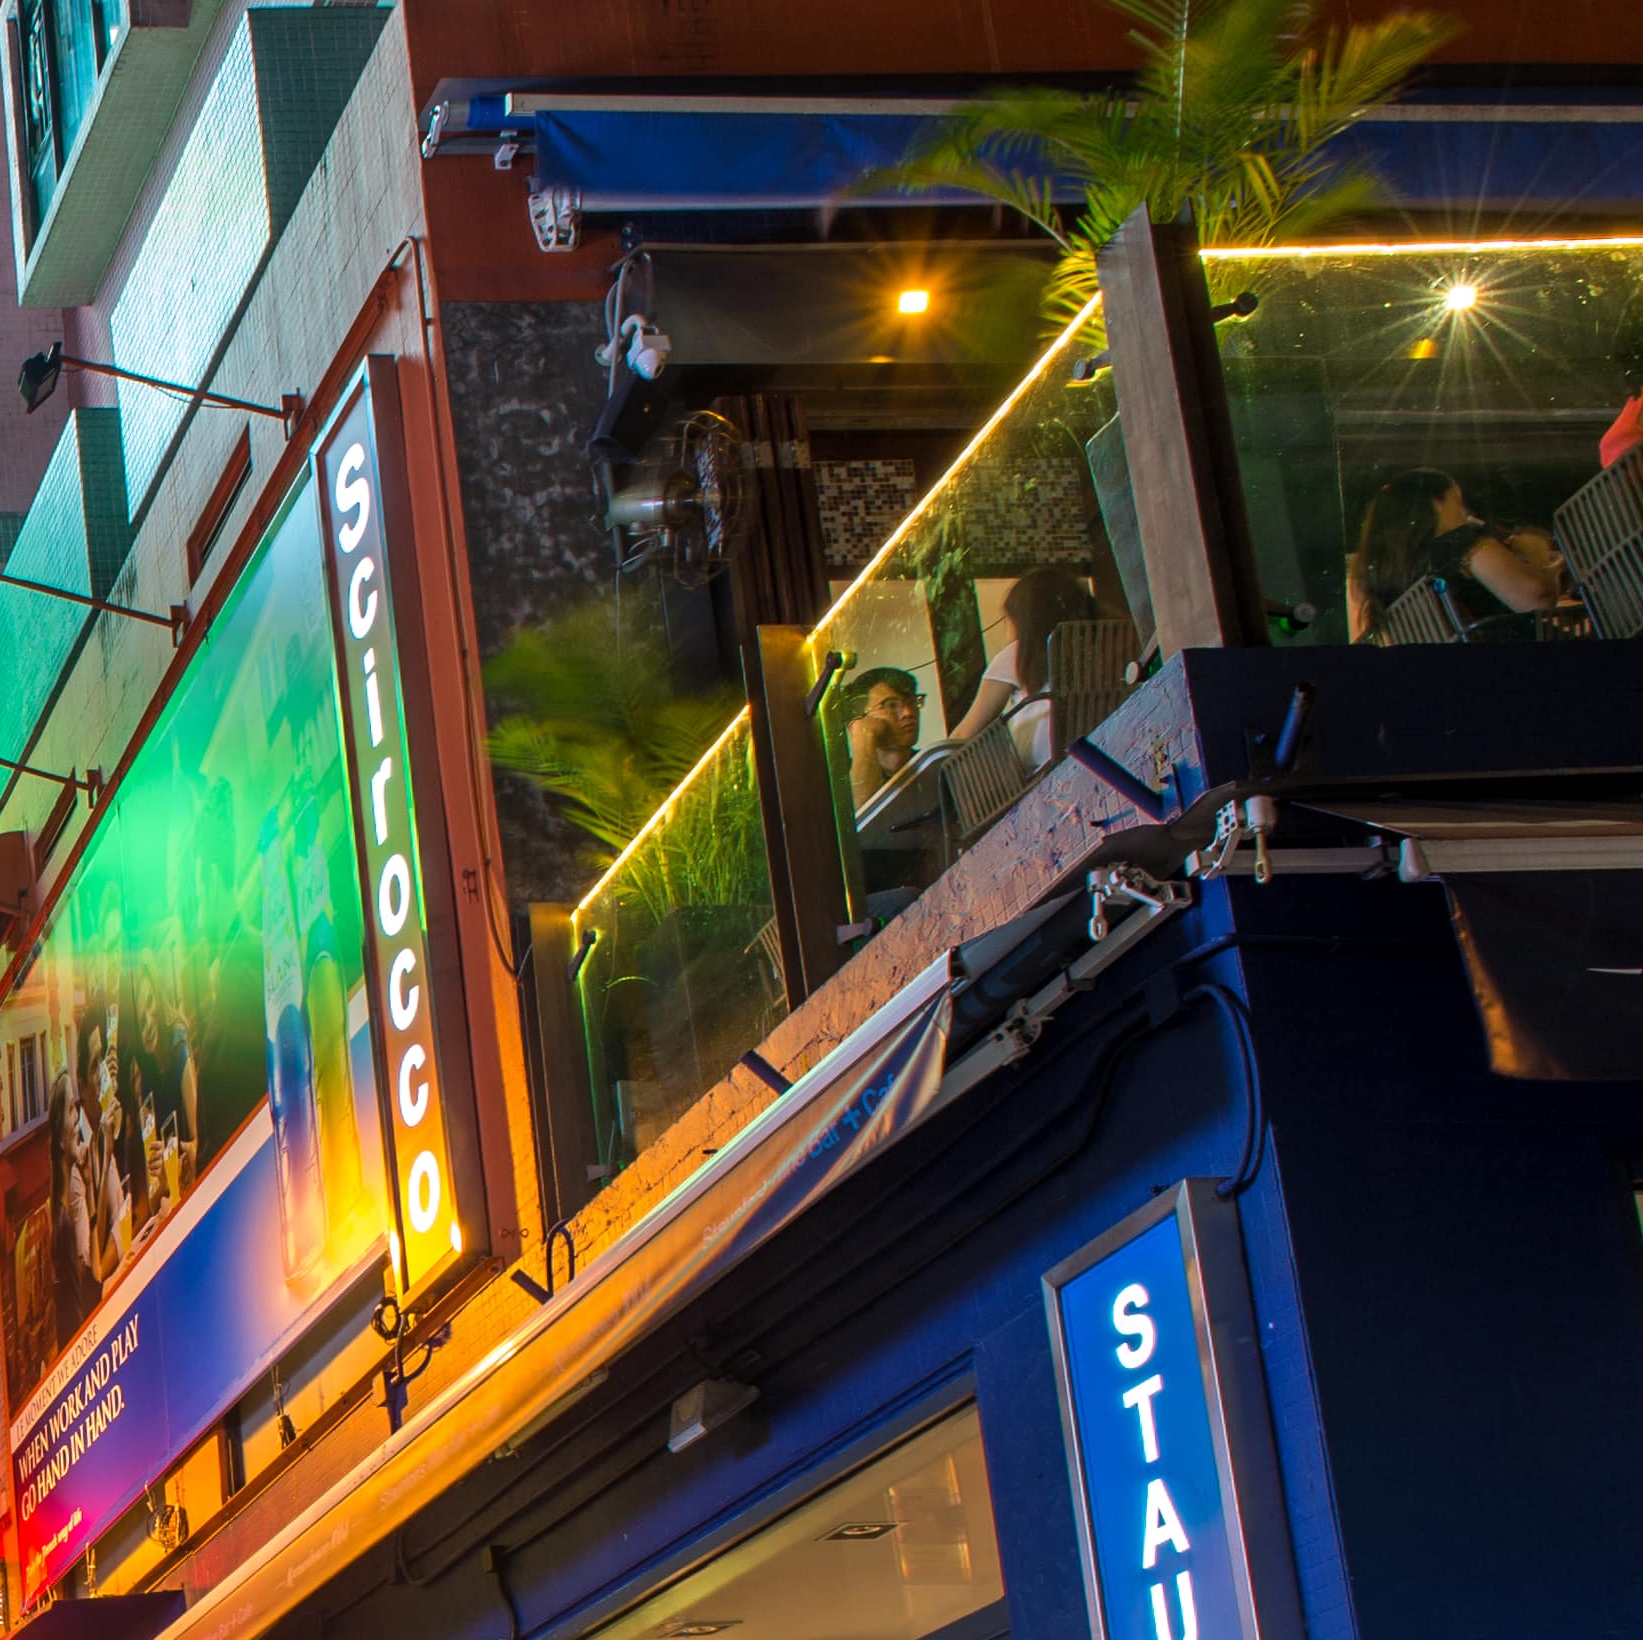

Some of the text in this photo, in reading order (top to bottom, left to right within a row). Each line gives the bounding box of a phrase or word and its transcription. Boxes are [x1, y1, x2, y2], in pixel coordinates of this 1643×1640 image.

[18, 1312, 141, 1485] WHEN WORK AND PLAY
[25, 1383, 57, 1431] MOMENT
[56, 1365, 70, 1390] WE
[69, 1323, 99, 1373] ADORE
[21, 1383, 126, 1522] GO HAND IN HAND.
